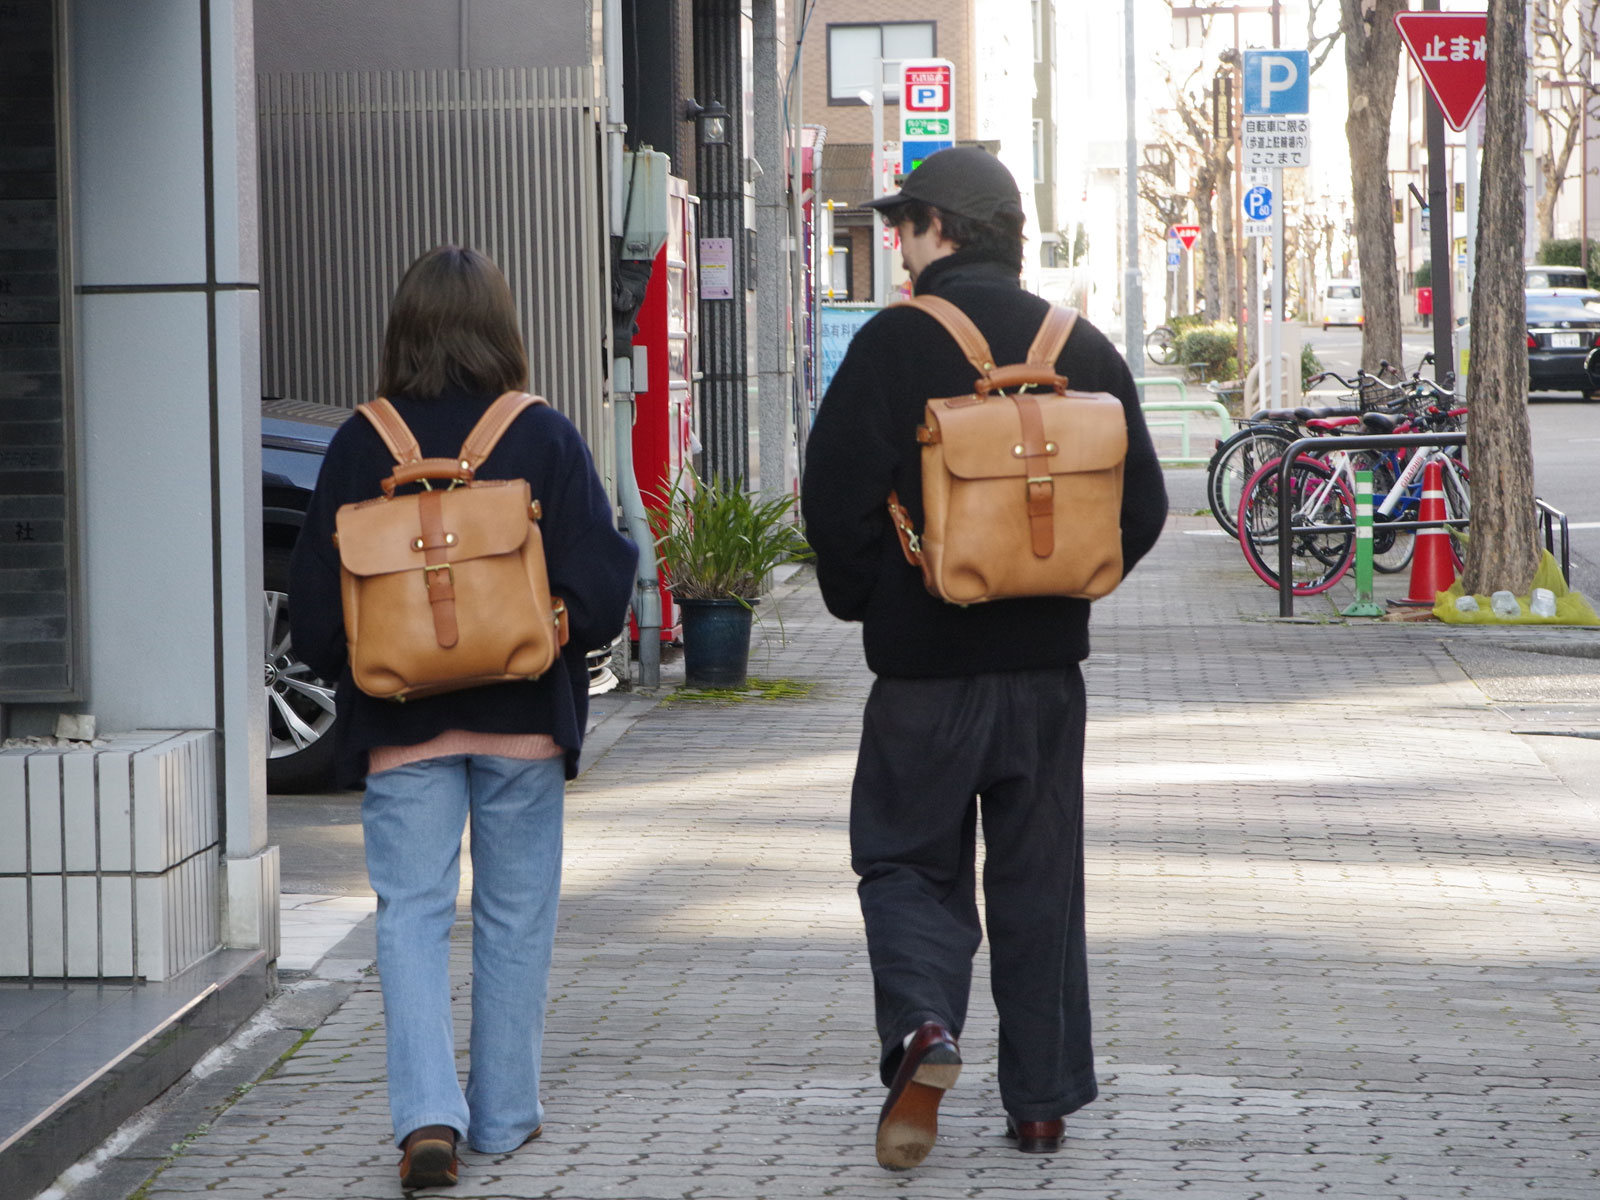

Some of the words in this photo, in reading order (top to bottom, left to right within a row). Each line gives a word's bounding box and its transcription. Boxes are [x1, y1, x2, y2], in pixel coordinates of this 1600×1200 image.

[1260, 56, 1298, 108] P
[918, 89, 936, 104] P
[909, 127, 925, 135] OK
[1246, 120, 1308, 133] 自転車に限る
[1251, 152, 1302, 165] ここまで
[1249, 194, 1264, 217] P
